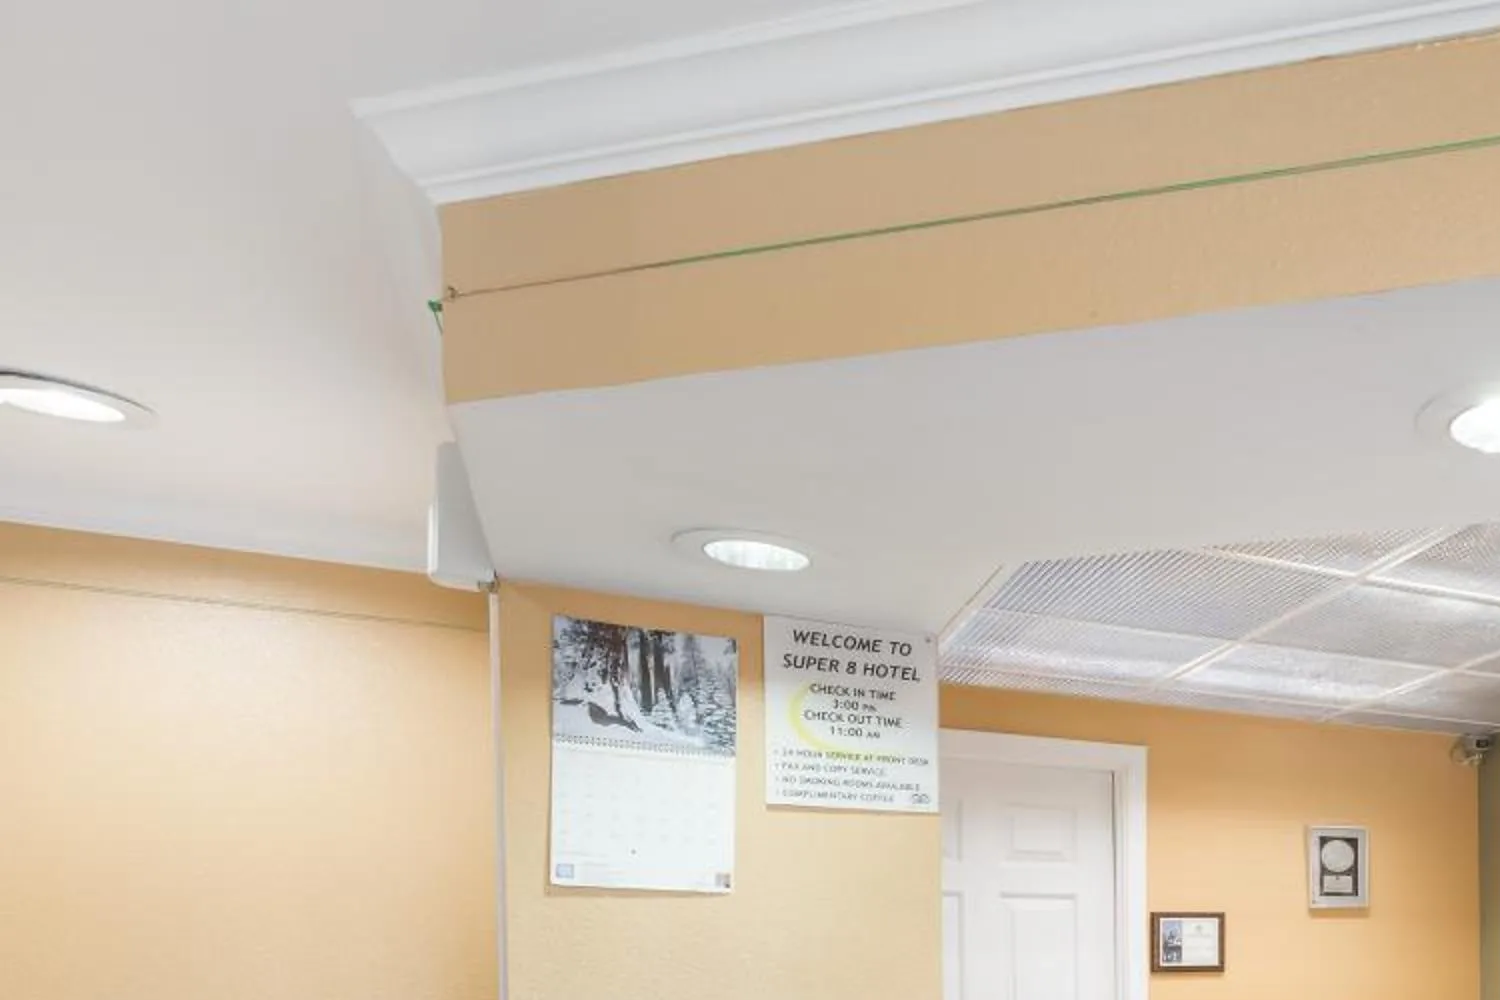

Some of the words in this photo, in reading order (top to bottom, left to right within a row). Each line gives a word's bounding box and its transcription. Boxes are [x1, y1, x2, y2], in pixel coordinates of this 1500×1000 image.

[793, 629, 882, 653] WELCOME
[890, 641, 912, 656] TO
[783, 653, 839, 673] SUPER
[845, 661, 857, 675] 8
[863, 663, 921, 682] HOTEL
[808, 683, 850, 697] CHECK
[853, 687, 865, 698] IN
[868, 689, 897, 701] TIME
[833, 698, 859, 711] 3:00
[803, 709, 845, 723] CHECK
[847, 713, 872, 725] OUT
[875, 715, 903, 728] TIME
[831, 725, 863, 737] 11:00
[825, 751, 861, 761] SERVICE
